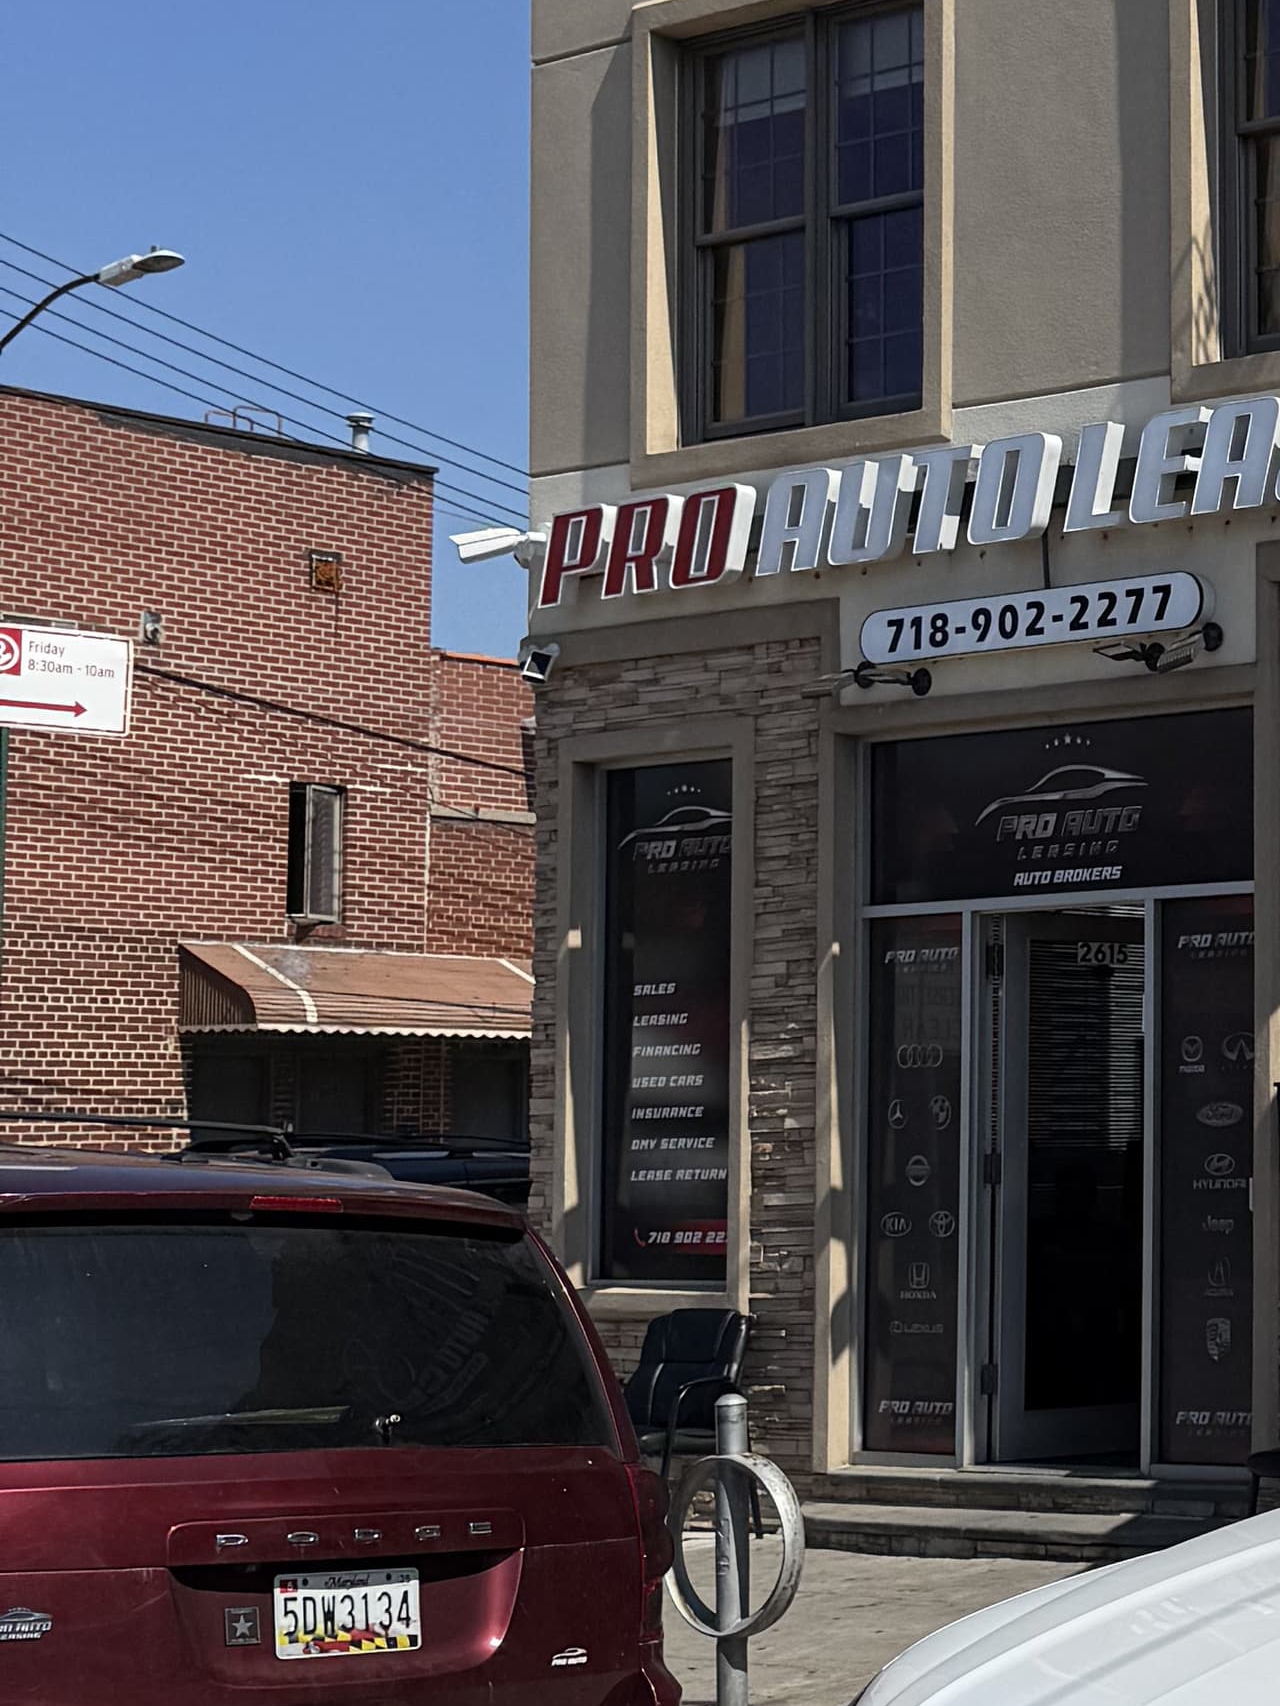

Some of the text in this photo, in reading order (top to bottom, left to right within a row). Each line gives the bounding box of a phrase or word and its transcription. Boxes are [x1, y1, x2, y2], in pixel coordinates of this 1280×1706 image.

[536, 482, 756, 608] PRO
[756, 432, 1063, 576] AUTO
[886, 583, 1174, 654] 718-902-2277
[28, 640, 65, 657] Friday
[28, 659, 73, 674] 8:30am
[86, 664, 115, 678] 10am
[996, 805, 1142, 842] PRO AUTO
[1017, 840, 1119, 860] LEASING
[1014, 866, 1122, 886] AUTO BROKERS
[1079, 943, 1128, 964] 2615
[633, 983, 676, 996] SALES
[633, 1013, 688, 1026] LEASING
[632, 1043, 701, 1057] FINANCING
[632, 1074, 704, 1088] USED CARS
[632, 1106, 704, 1119] INSURANCE
[631, 1137, 715, 1150] DMV SERVICE
[631, 1168, 727, 1182] LEASE RETURN
[648, 1230, 727, 1244] 718 902 22
[283, 1589, 412, 1637] 5DW3134
